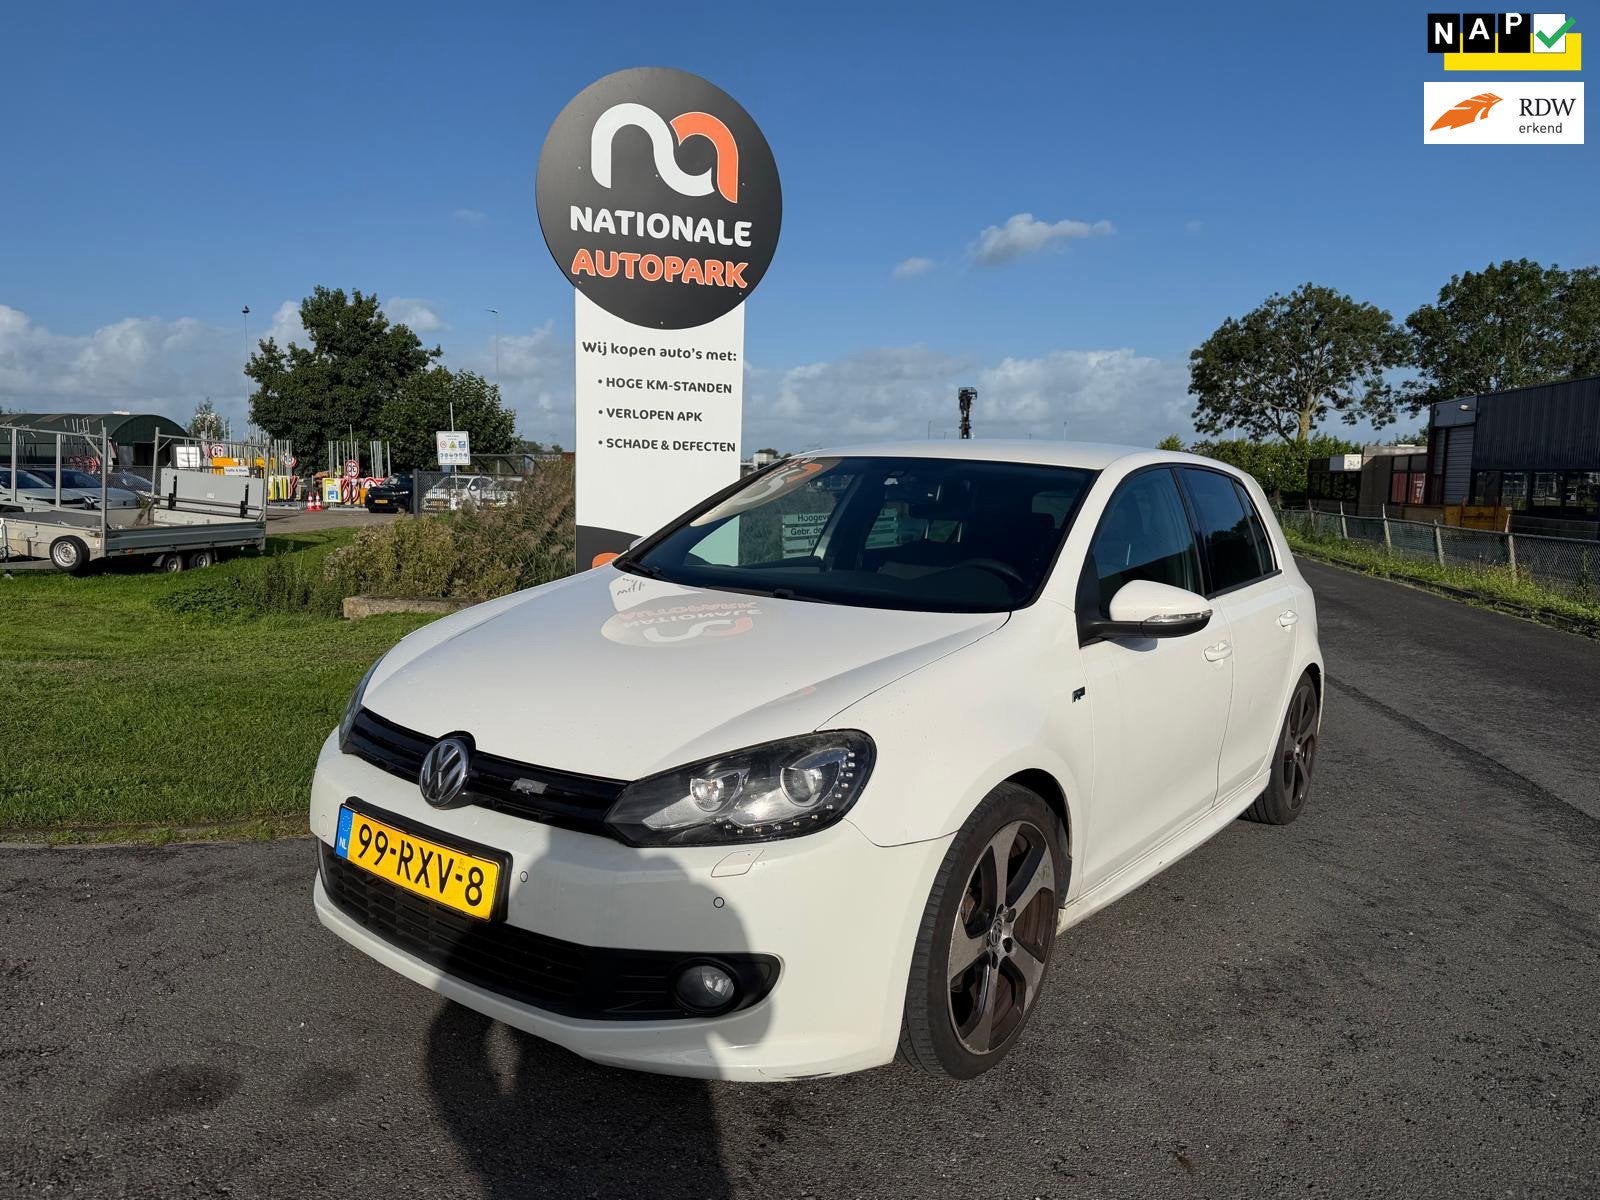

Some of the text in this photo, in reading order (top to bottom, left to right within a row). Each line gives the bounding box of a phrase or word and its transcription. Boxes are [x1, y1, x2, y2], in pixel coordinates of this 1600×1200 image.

[570, 205, 752, 248] NATIONALE
[571, 248, 749, 289] AUTOPARK
[582, 341, 737, 362] Wij kopen auto's met:
[606, 377, 732, 394] HOGE KM-STANDEN
[606, 407, 703, 422] VERLOPEN APK
[606, 438, 736, 452] SCHADE & DEFECTEN
[797, 514, 828, 522] Hoogev
[338, 837, 348, 850] NL
[358, 823, 485, 907] 99-RXV-8
